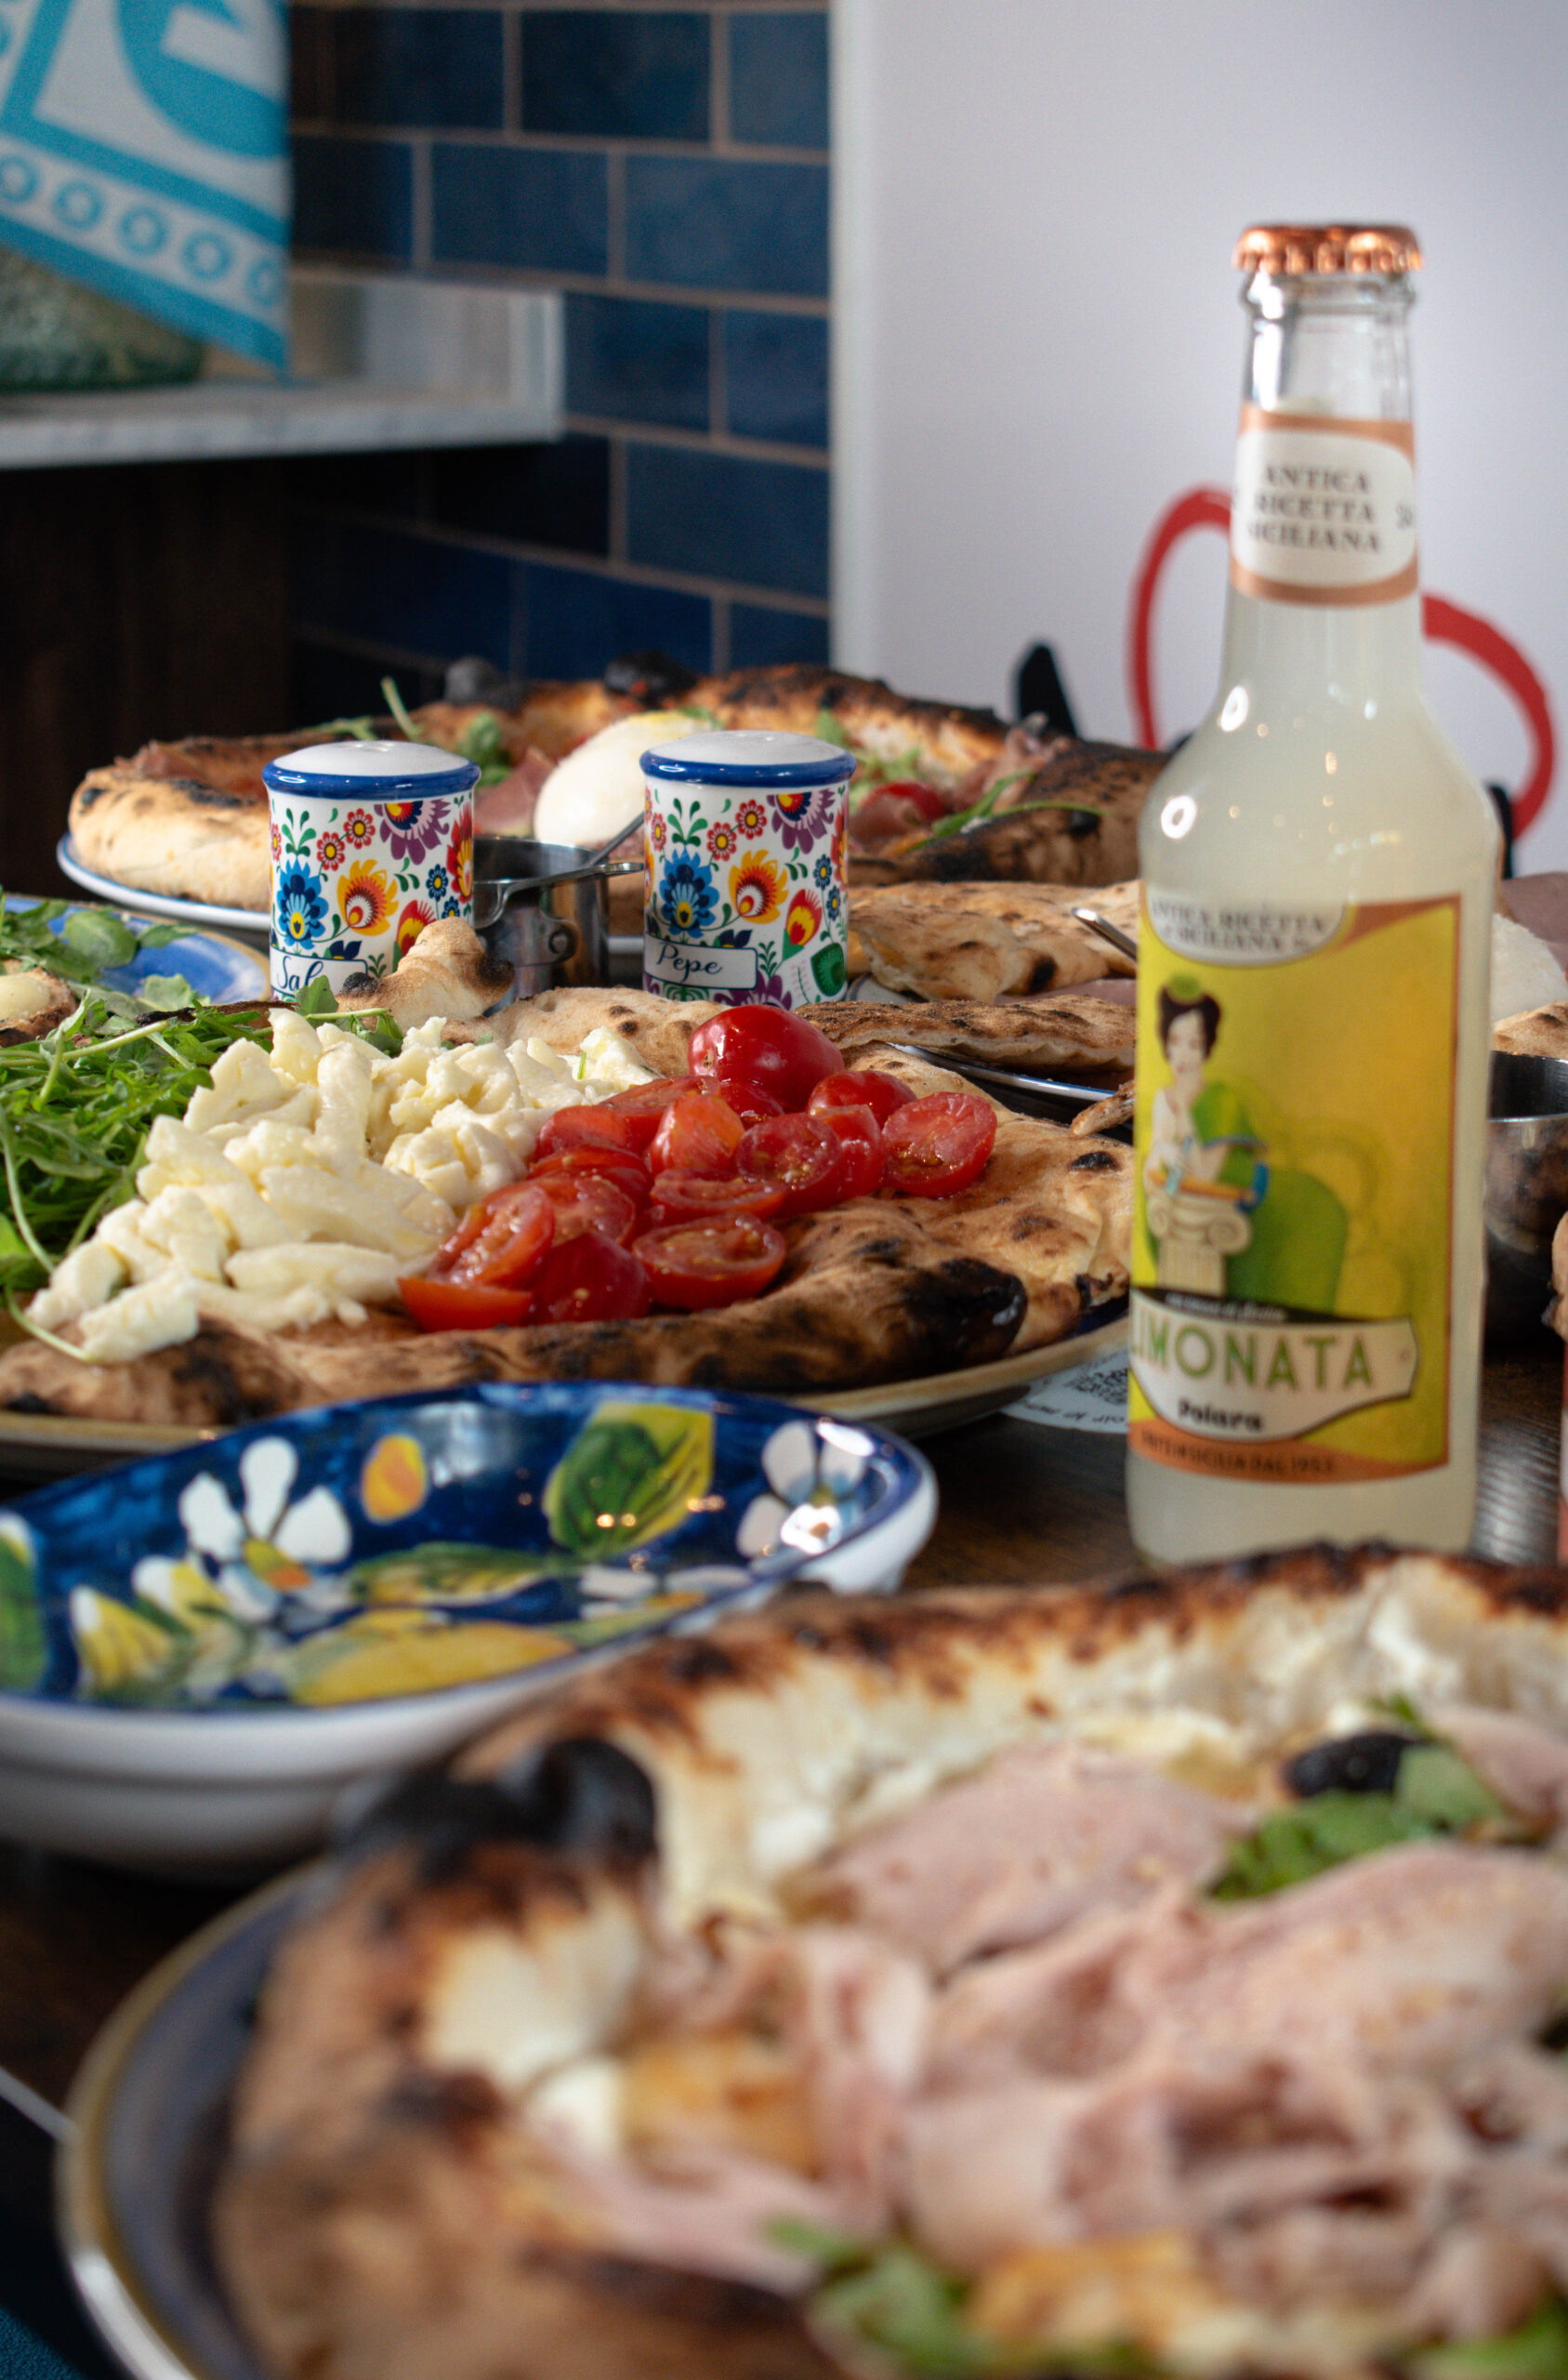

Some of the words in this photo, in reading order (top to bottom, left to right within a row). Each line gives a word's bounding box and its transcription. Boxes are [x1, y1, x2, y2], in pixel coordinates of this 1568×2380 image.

[1266, 466, 1371, 494] ANTICA
[277, 954, 324, 993] Sal
[654, 941, 723, 983] Pepe
[1178, 1398, 1263, 1432] Polara
